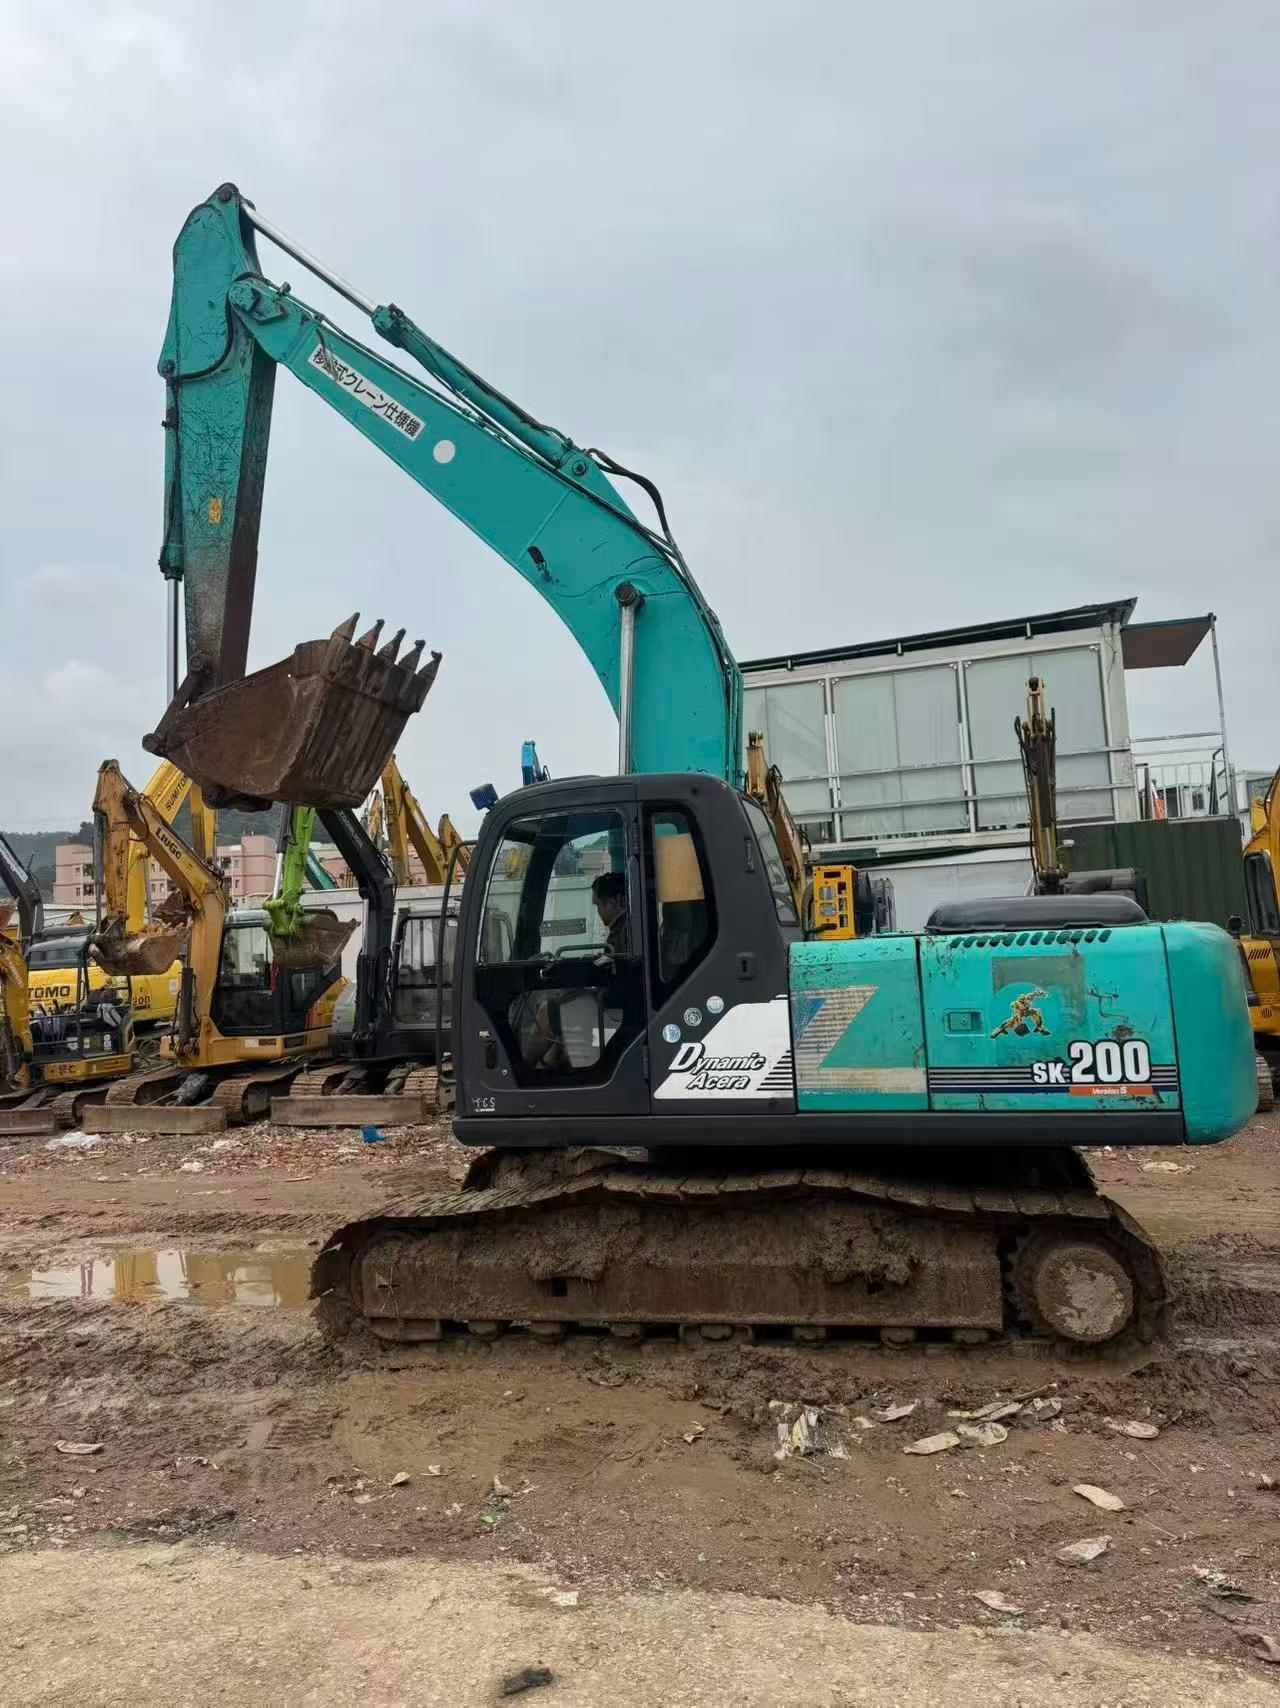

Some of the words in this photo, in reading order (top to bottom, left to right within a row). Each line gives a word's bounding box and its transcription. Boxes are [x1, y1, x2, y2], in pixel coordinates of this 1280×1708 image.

[312, 347, 422, 438] 移式クレーン仕様機
[668, 1042, 766, 1076] Dynamic
[685, 1071, 751, 1091] Acera
[1120, 1086, 1127, 1094] S
